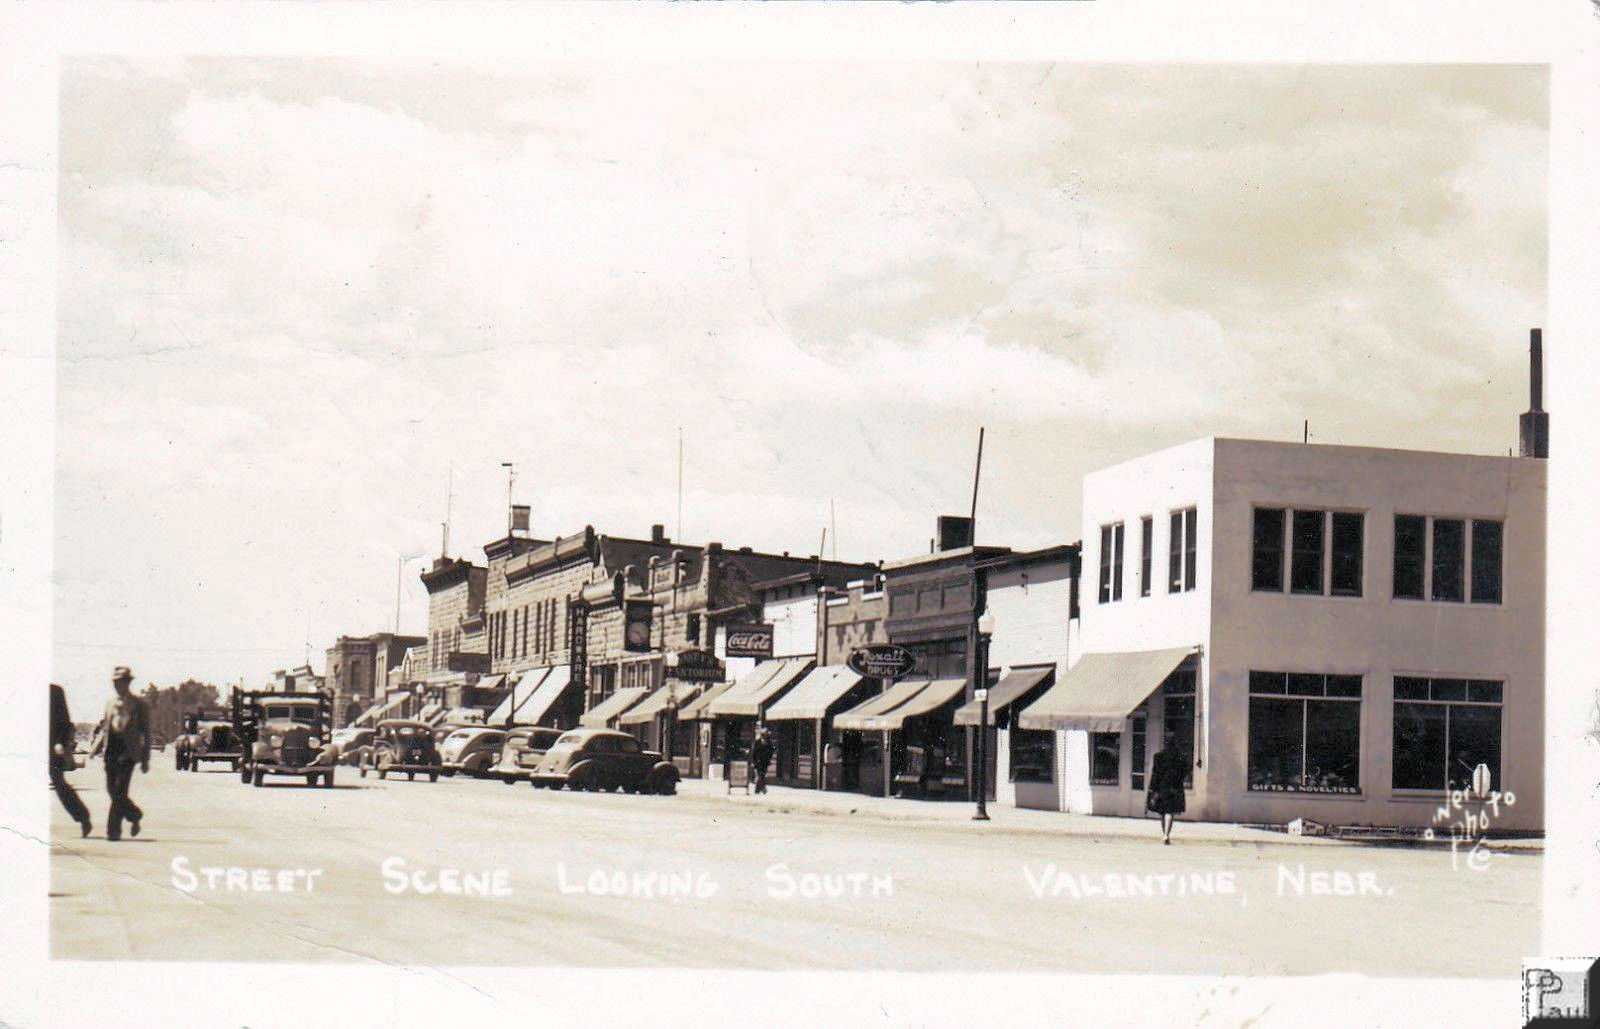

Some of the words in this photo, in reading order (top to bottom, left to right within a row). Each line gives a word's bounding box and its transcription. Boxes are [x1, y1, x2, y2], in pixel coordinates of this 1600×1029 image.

[574, 607, 584, 682] HARDWARE
[1252, 783, 1284, 791] GIFTS
[1287, 784, 1295, 792] &
[1299, 785, 1357, 794] NOVELTIES
